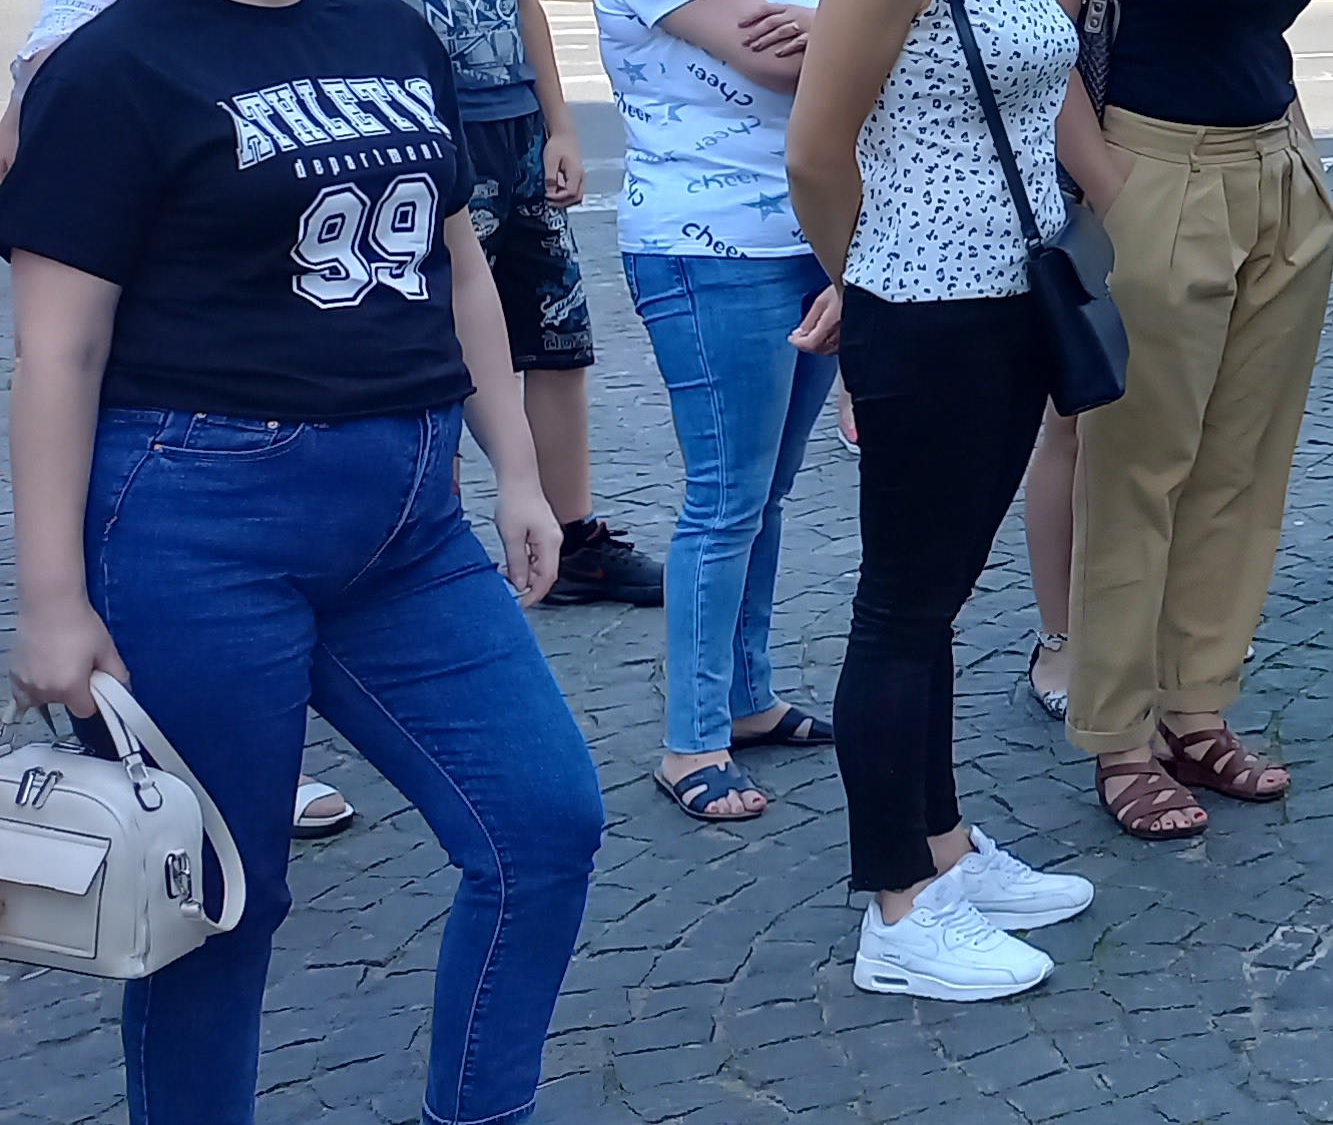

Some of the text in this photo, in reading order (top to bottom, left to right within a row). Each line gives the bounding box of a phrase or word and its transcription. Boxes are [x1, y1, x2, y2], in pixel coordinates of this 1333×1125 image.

[686, 62, 754, 107] cheer
[216, 77, 452, 170] ATHLETIC
[694, 114, 762, 152] cheer
[293, 140, 444, 179] department
[687, 172, 763, 194] cheer
[290, 172, 439, 309] 99
